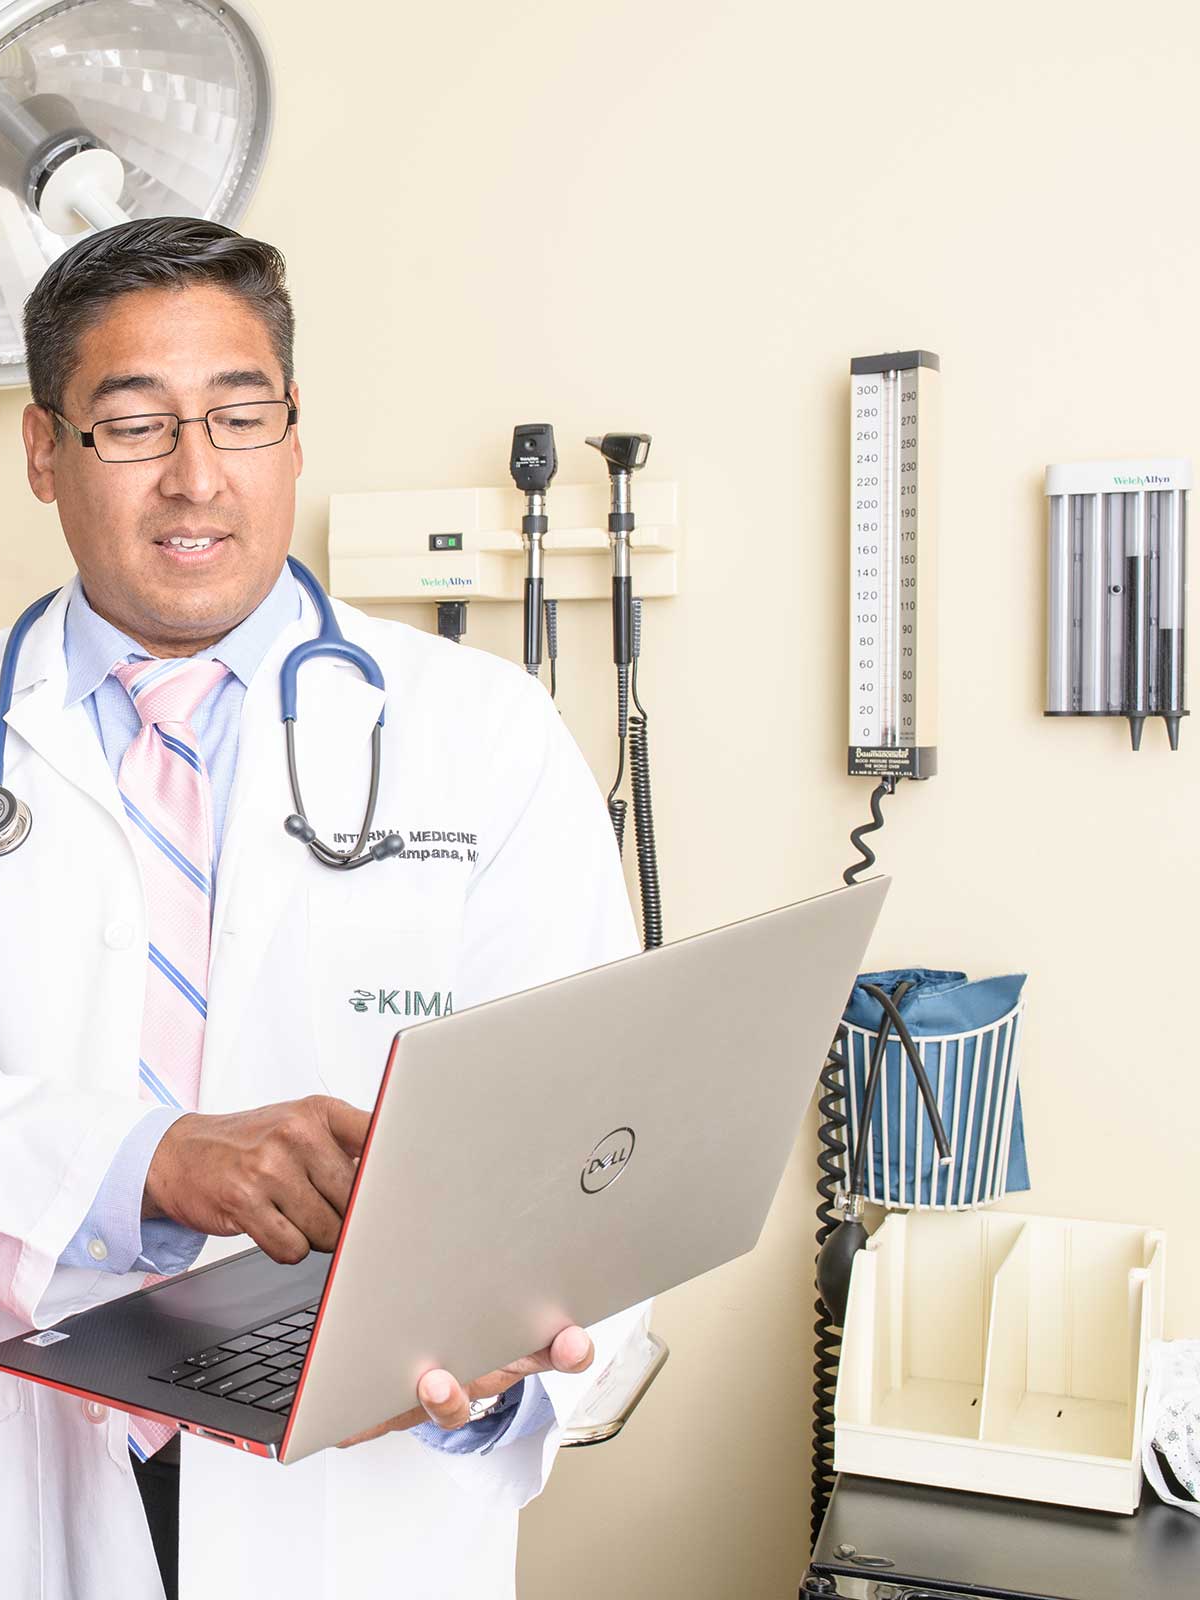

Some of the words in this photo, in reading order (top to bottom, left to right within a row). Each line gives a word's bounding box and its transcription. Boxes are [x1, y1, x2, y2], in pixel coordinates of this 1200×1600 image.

[857, 385, 879, 395] 300
[901, 391, 917, 402] 290
[857, 408, 879, 418] 280
[901, 414, 917, 426] 270
[857, 431, 879, 441] 260
[901, 438, 917, 449] 250
[857, 454, 879, 464] 240
[901, 462, 917, 473] 230
[857, 477, 879, 487] 220
[1113, 475, 1170, 486] WelchAllyn
[901, 485, 917, 496] 210
[857, 500, 879, 509] 200
[901, 507, 917, 518] 190
[857, 522, 879, 532] 180
[901, 530, 917, 541] 170
[857, 545, 879, 554] 160
[901, 553, 917, 564] 150
[857, 568, 879, 577] 140
[420, 577, 473, 588] WelchAllyn
[901, 576, 917, 588] 130
[857, 591, 879, 600] 120
[901, 600, 917, 611] 110
[857, 614, 879, 623] 100
[902, 623, 913, 635] 90
[858, 637, 875, 646] 80
[902, 646, 913, 657] 70
[858, 660, 875, 669] 60
[902, 669, 913, 681] 50
[858, 683, 875, 692] 40
[902, 692, 913, 704] 30
[858, 706, 875, 715] 20
[902, 715, 913, 727] 10
[862, 728, 871, 737] 0
[333, 829, 400, 844] INTRN
[409, 830, 478, 846] MEDICINE
[393, 848, 464, 862] ampana,
[467, 849, 479, 863] M
[379, 989, 453, 1017] KIMA
[588, 1148, 626, 1175] DELL
